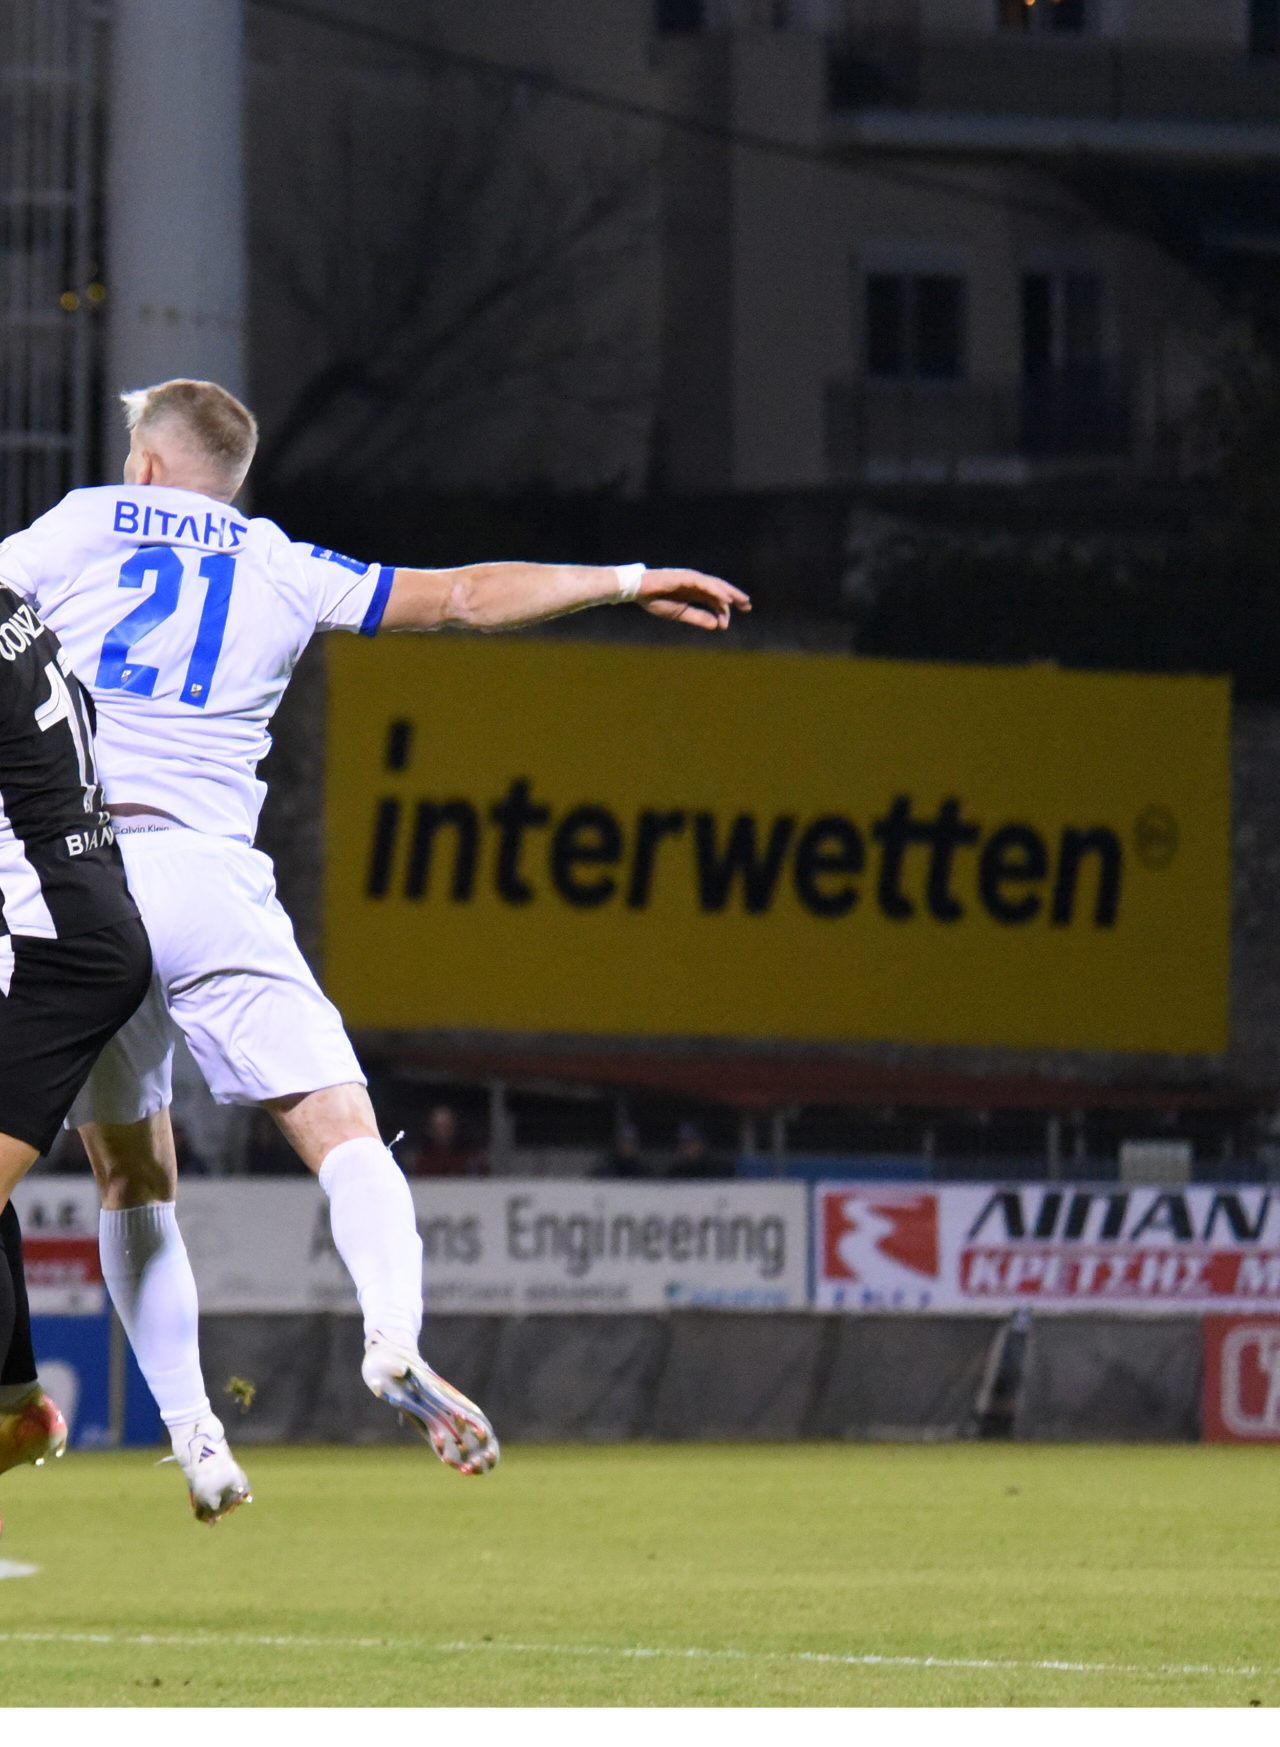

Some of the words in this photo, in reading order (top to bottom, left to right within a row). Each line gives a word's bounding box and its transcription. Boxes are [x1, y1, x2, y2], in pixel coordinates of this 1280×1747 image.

[113, 501, 248, 548] ΒΙΤΛΗΣ
[95, 544, 237, 709] 21
[113, 824, 146, 836] alvin
[364, 716, 1123, 930] interwetten
[507, 1194, 786, 1279] Engineering
